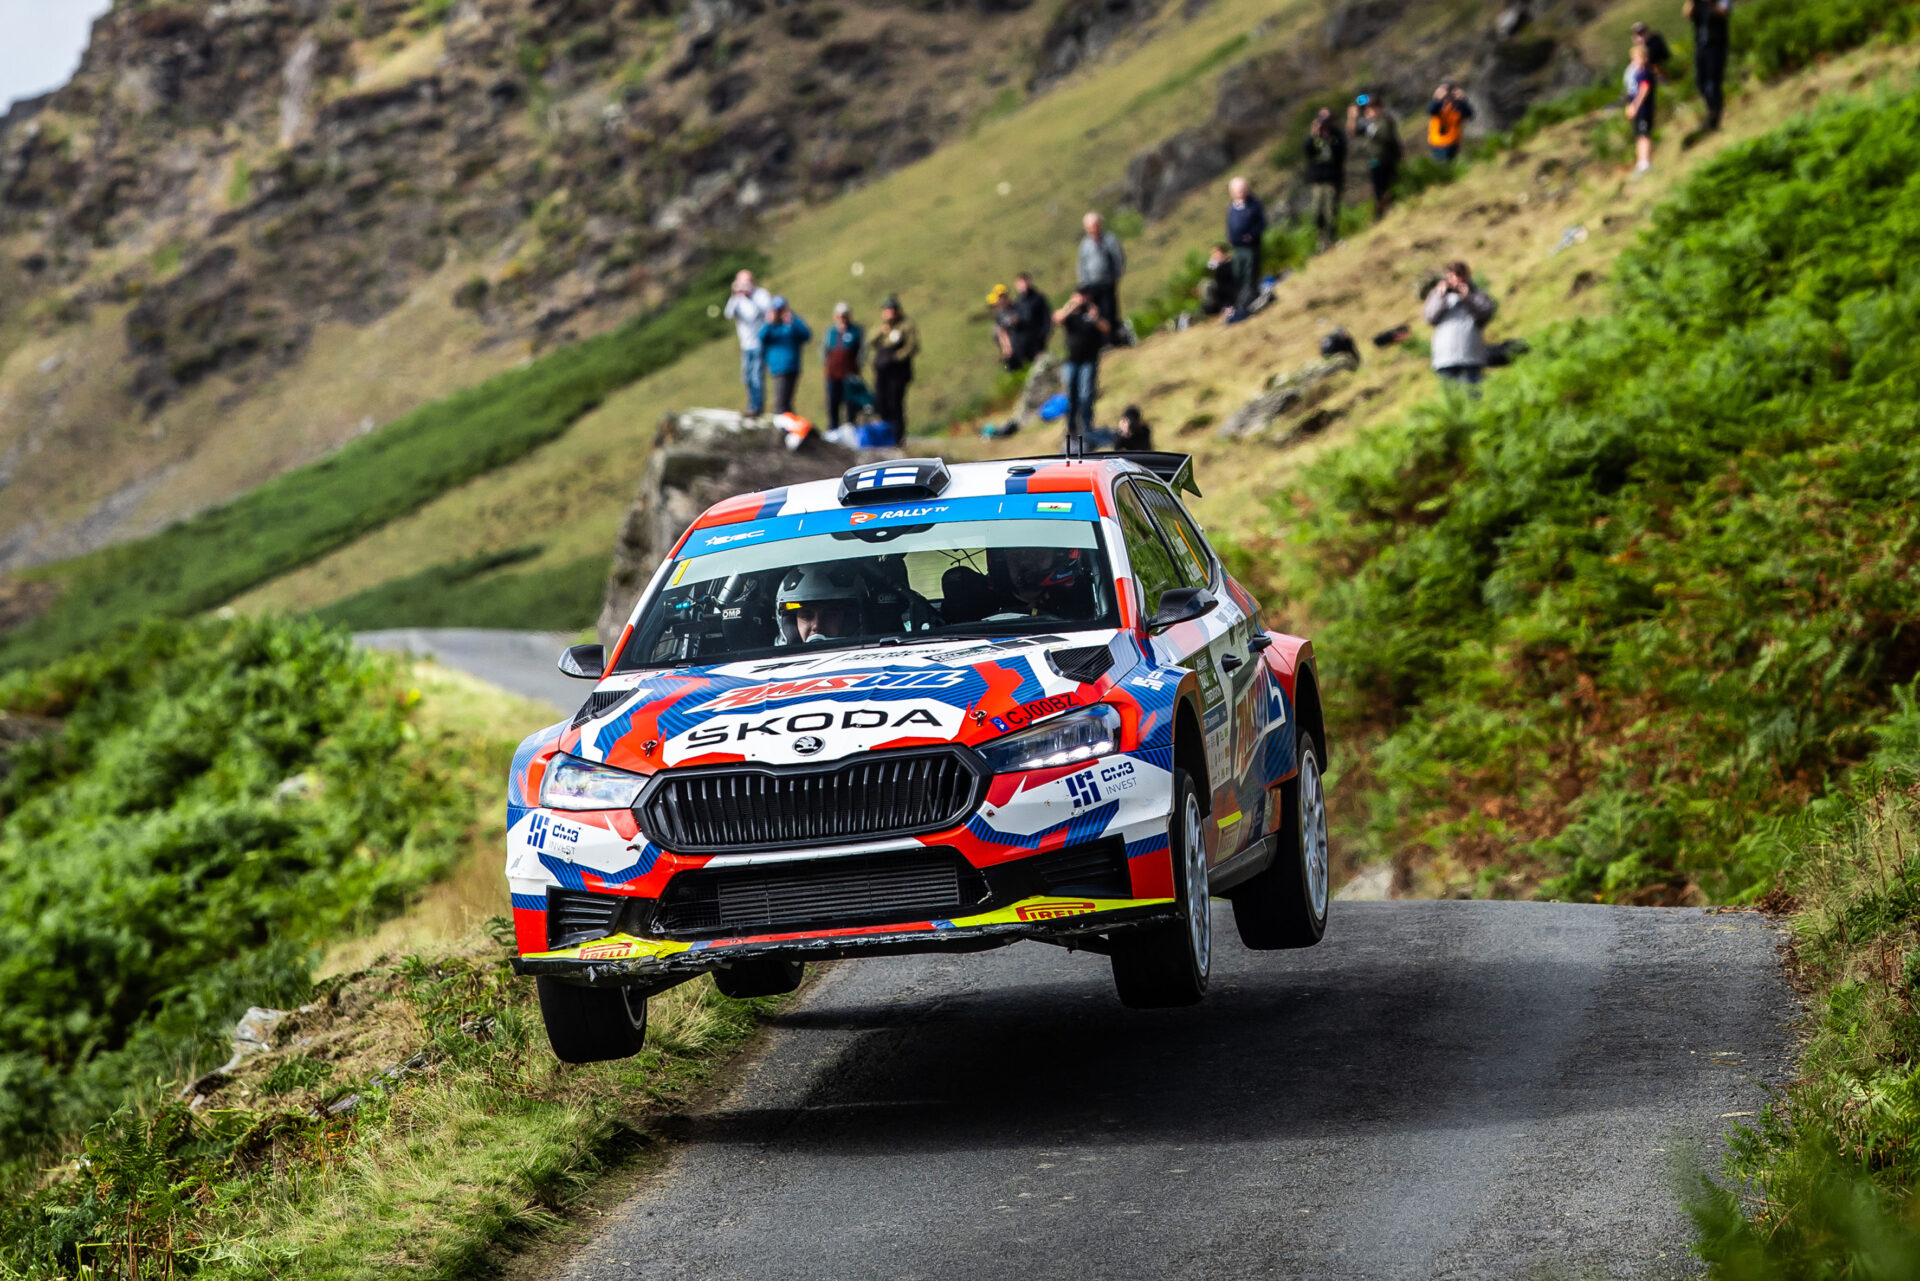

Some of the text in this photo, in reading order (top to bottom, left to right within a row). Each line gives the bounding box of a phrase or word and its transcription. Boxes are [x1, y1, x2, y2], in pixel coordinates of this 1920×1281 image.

[722, 608, 742, 619] OMP
[686, 670, 966, 713] AMSOIL
[1101, 761, 1135, 783] CM3
[1105, 776, 1138, 796] INVEST
[579, 942, 633, 961] PIRELLI
